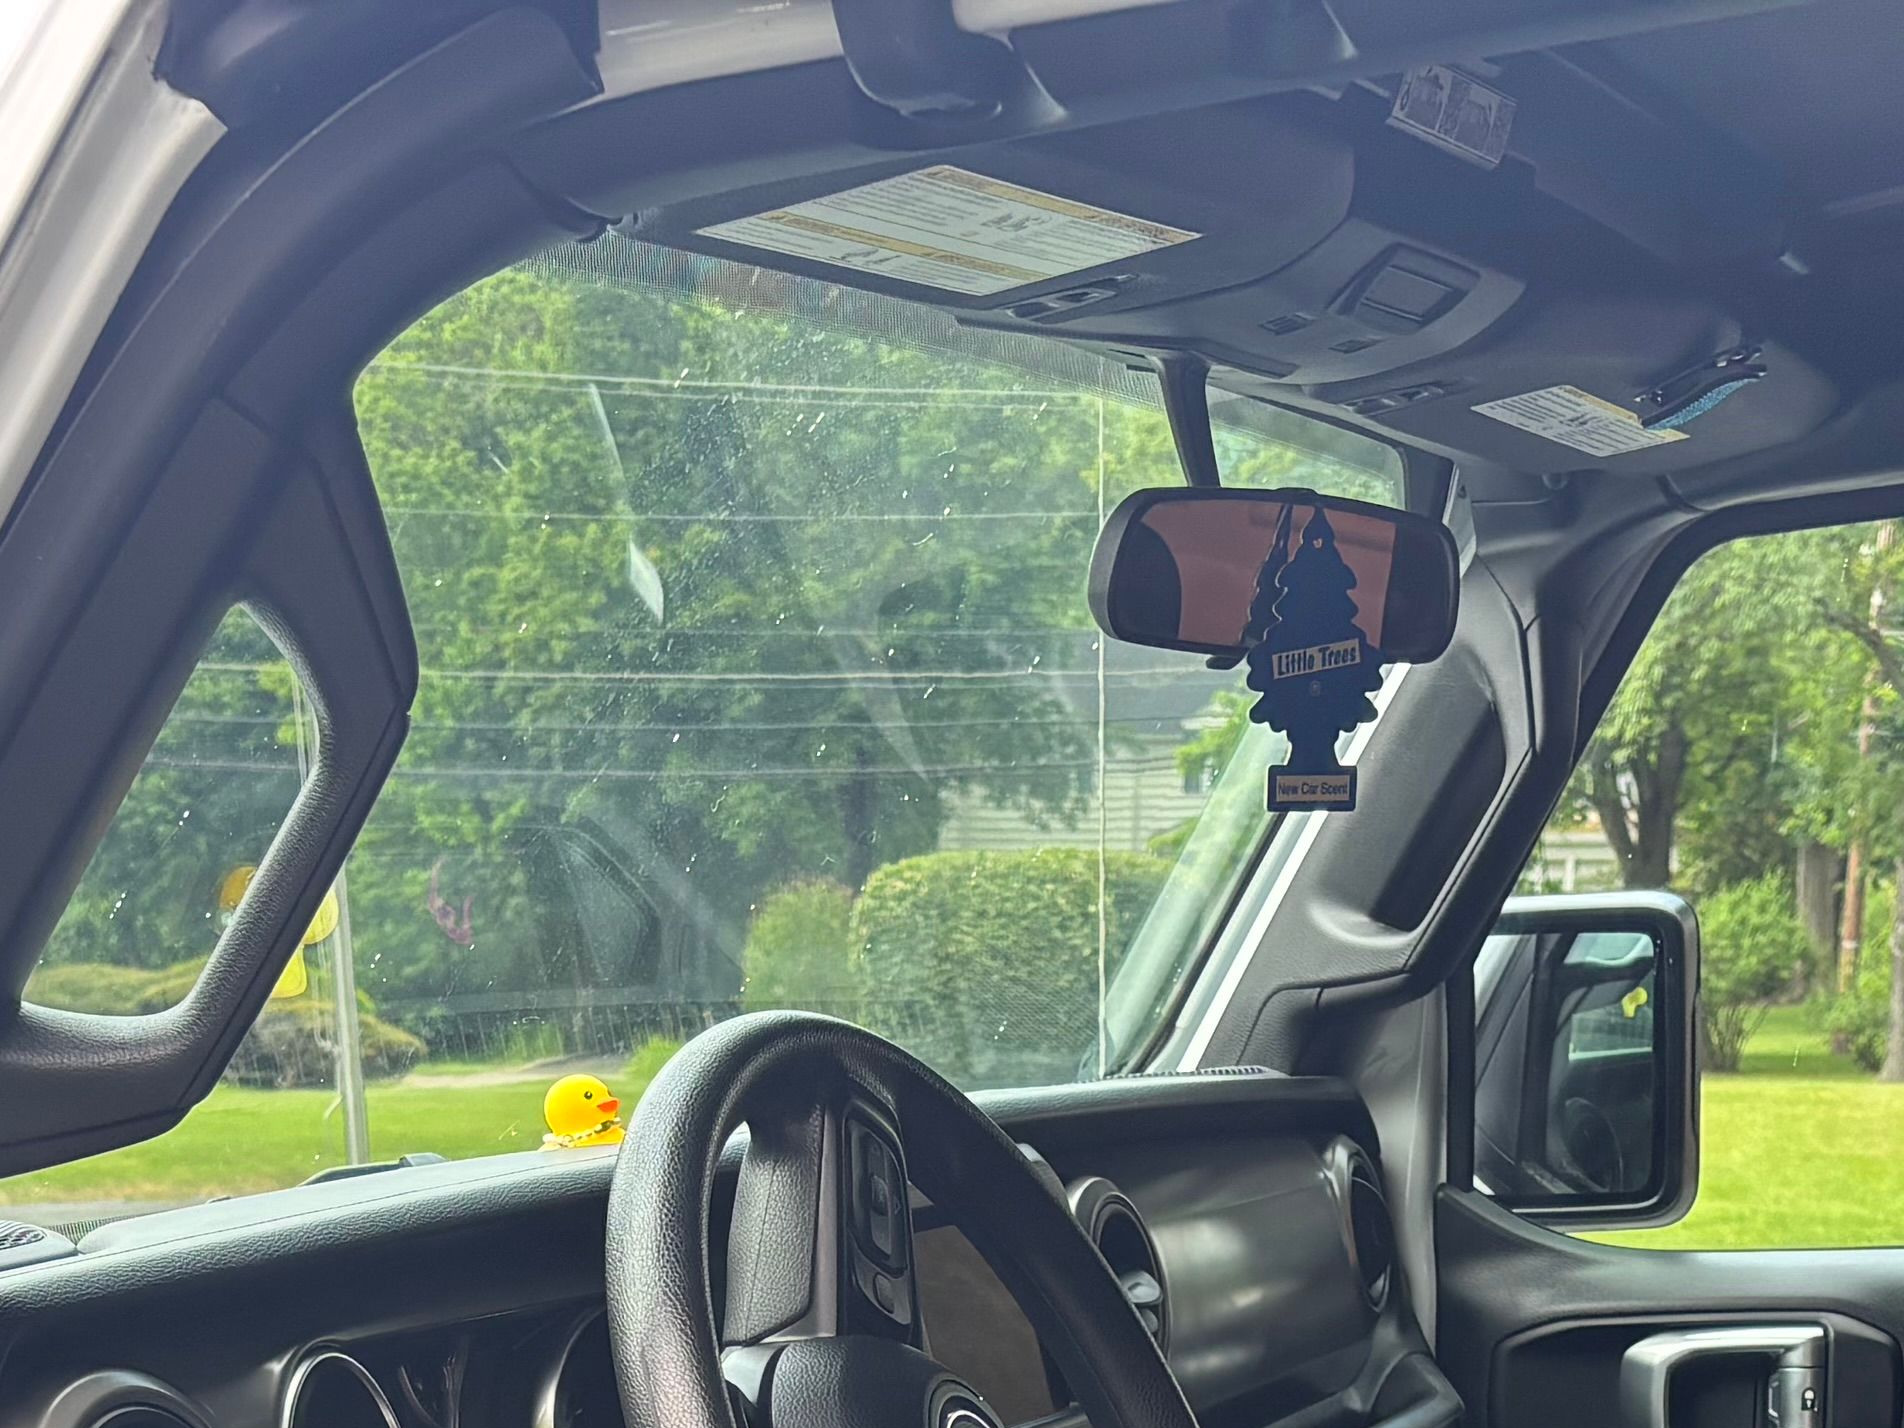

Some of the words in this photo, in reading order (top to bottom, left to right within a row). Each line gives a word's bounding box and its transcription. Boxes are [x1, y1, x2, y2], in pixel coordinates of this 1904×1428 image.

[1277, 651, 1315, 676] Little
[1318, 645, 1357, 668] Trees
[1278, 784, 1298, 796] New
[1300, 782, 1319, 796] Car
[1321, 782, 1349, 796] Scent
